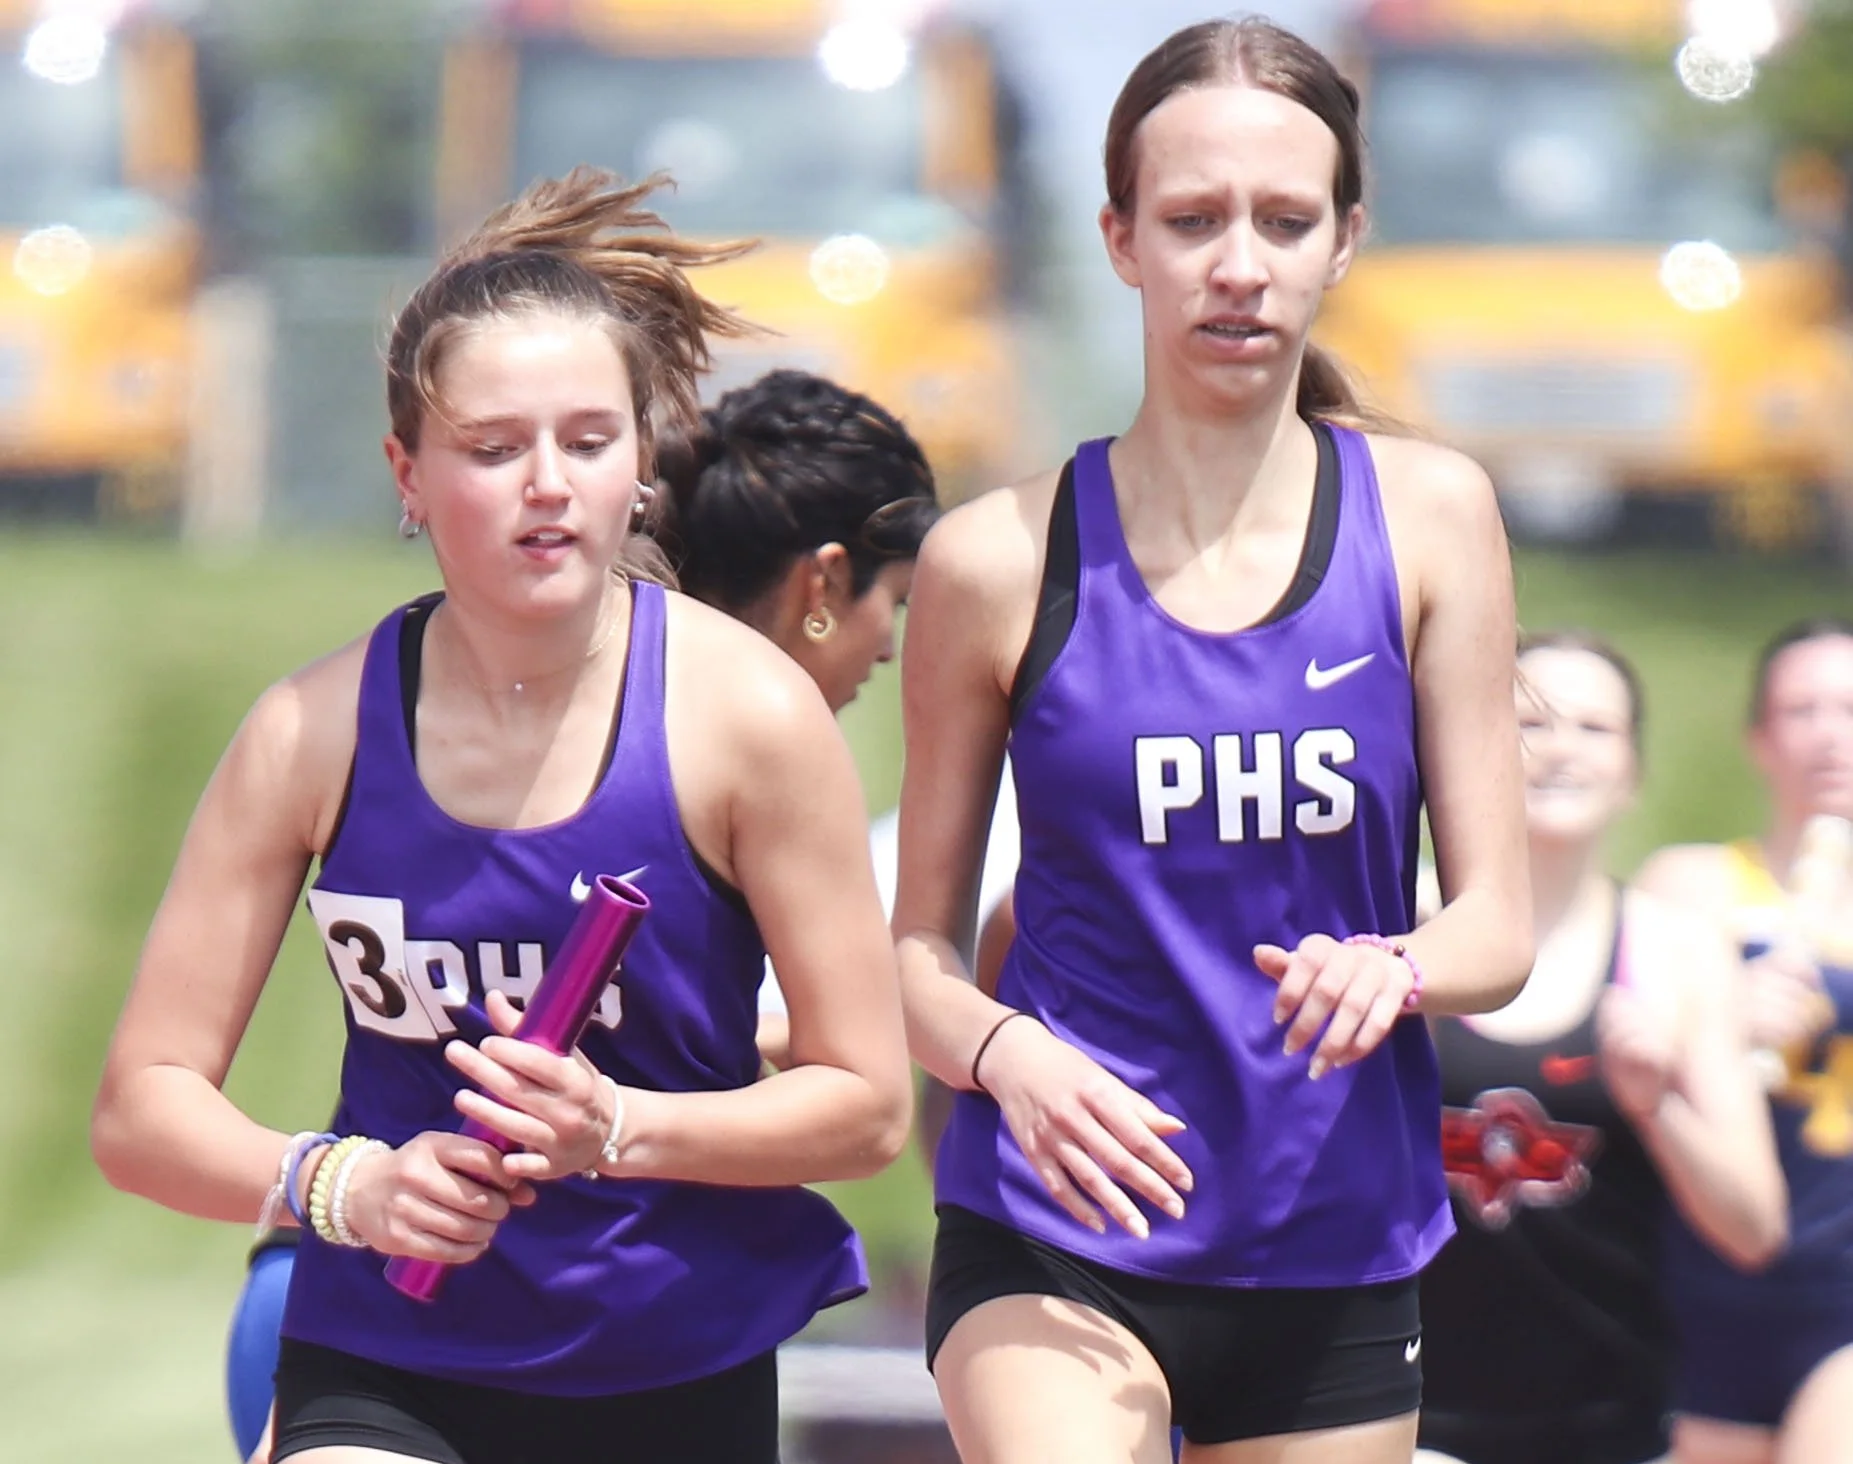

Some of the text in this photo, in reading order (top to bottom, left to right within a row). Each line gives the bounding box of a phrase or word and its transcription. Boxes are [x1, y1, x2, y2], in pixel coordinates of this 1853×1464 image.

[1134, 726, 1356, 844] PHS
[328, 919, 407, 1019] 3
[404, 938, 625, 1034] PH
